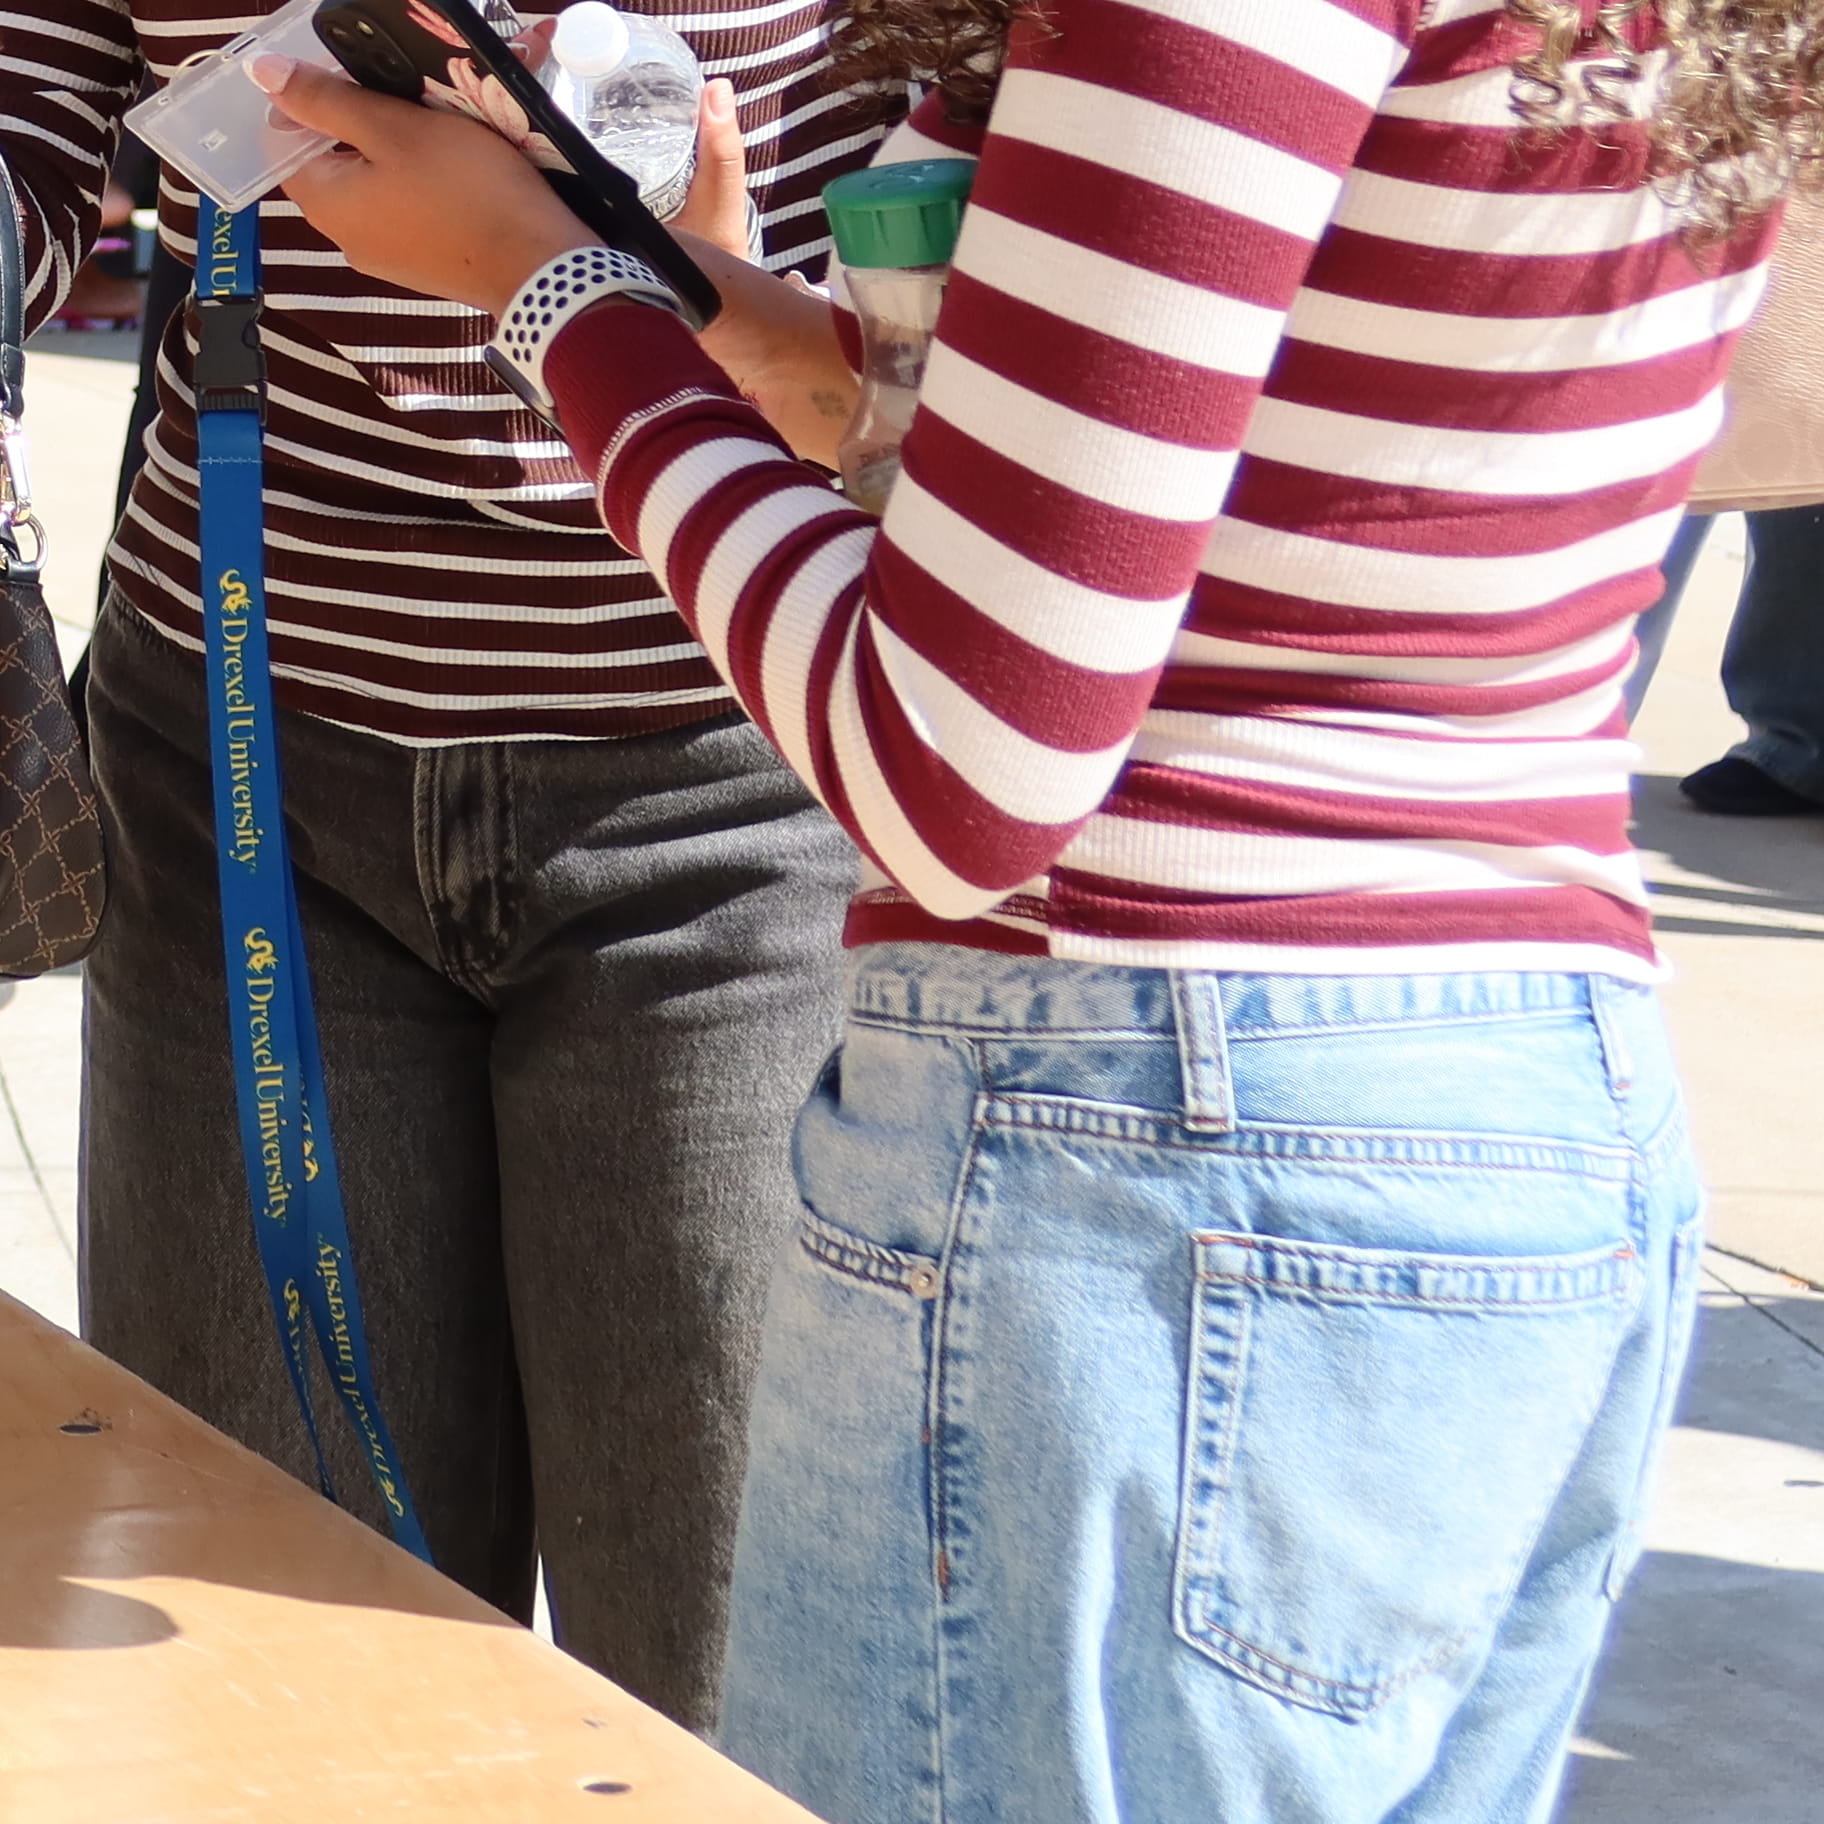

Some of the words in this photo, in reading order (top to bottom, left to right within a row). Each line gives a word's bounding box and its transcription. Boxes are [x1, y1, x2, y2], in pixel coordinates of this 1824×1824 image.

[213, 208, 239, 260] exel
[221, 618, 255, 714] Drexel
[227, 718, 263, 872] University
[246, 977, 284, 1074] Drexel
[256, 1077, 292, 1226] University
